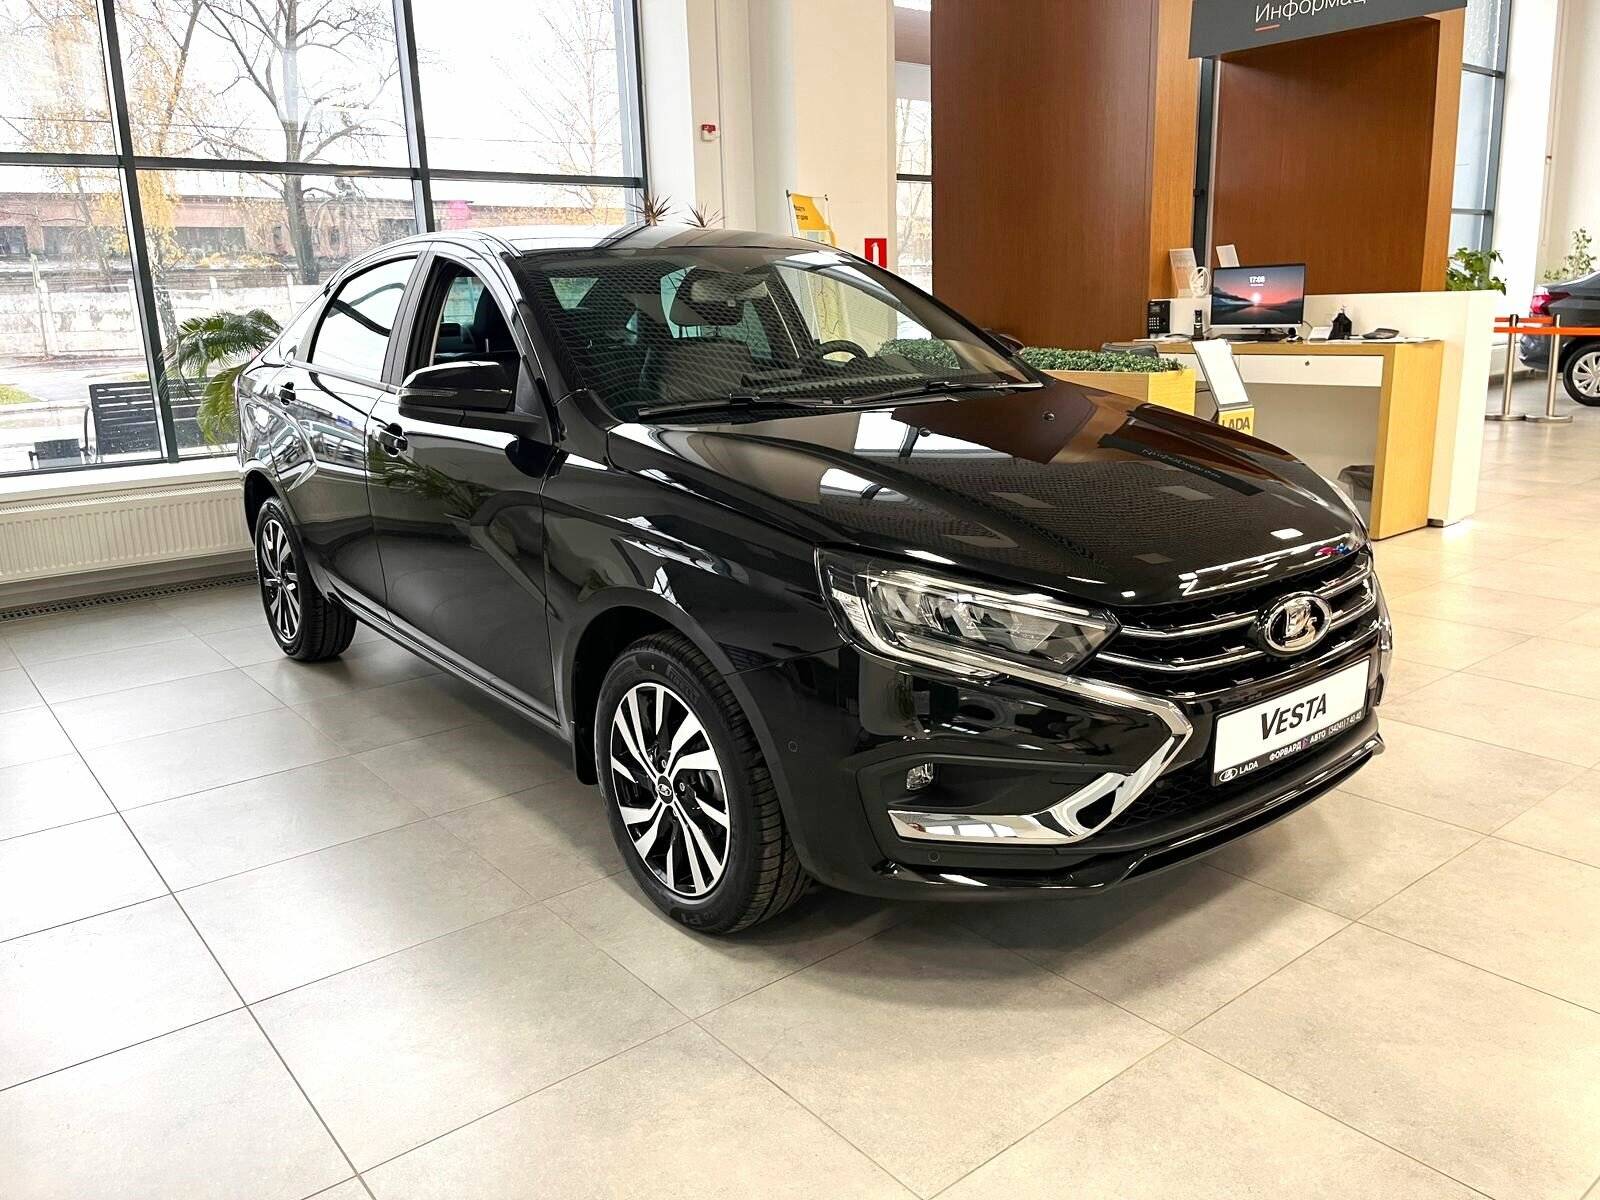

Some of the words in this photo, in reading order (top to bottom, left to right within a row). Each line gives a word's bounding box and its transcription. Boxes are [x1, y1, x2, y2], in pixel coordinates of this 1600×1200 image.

[1255, 0, 1366, 23] Информ
[1261, 693, 1327, 741] VESTA
[1239, 760, 1259, 775] LADA
